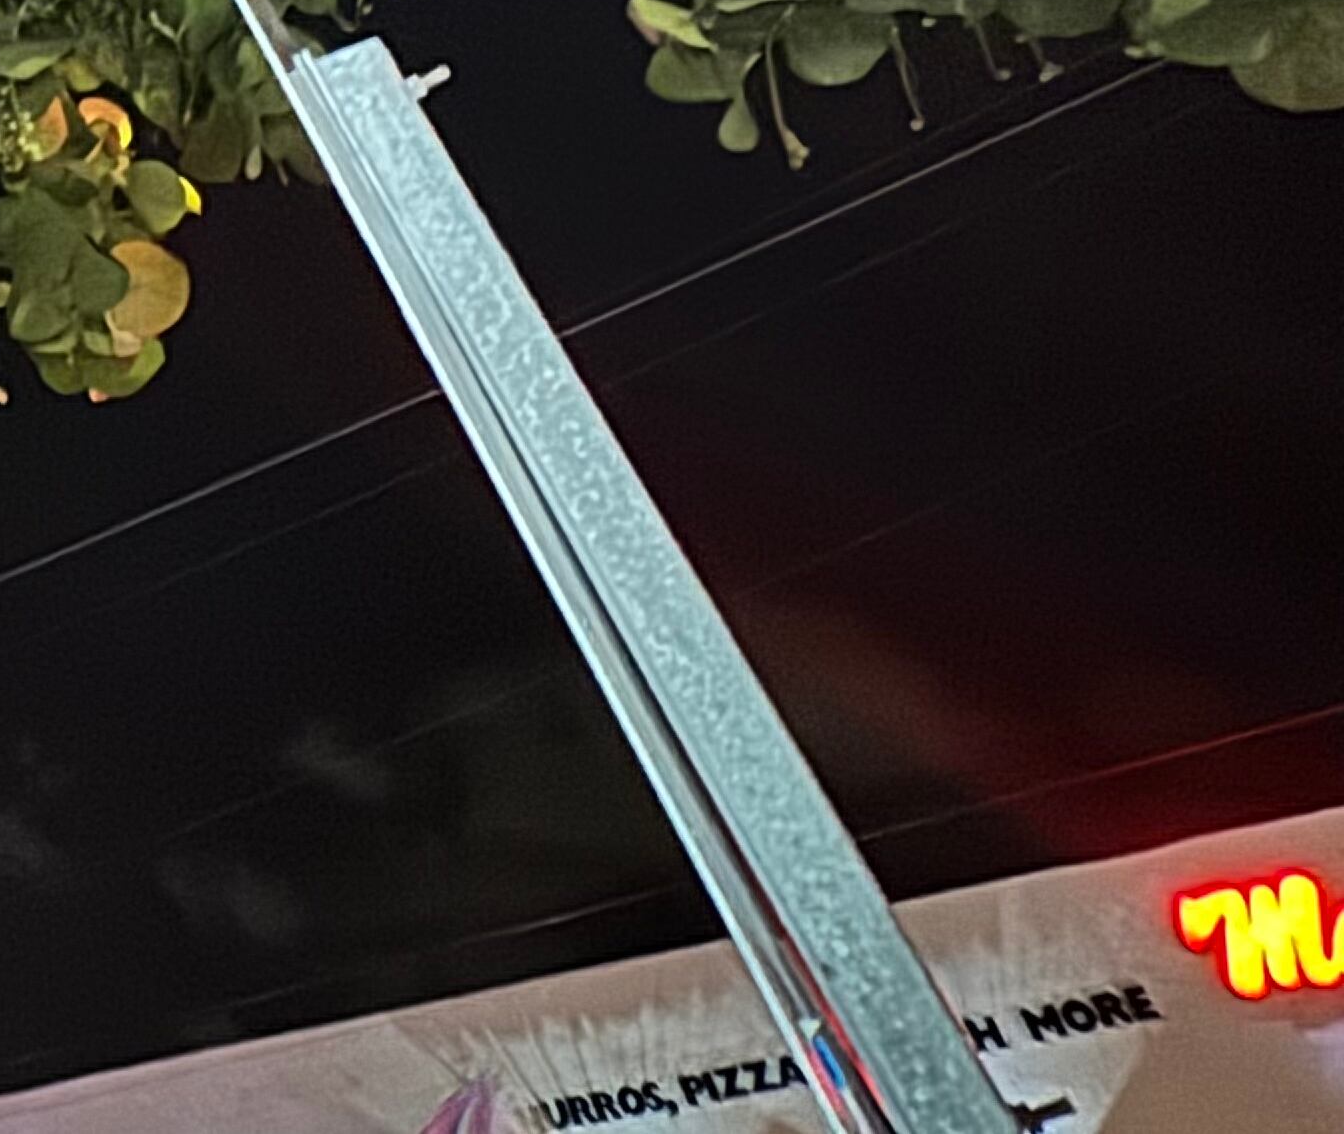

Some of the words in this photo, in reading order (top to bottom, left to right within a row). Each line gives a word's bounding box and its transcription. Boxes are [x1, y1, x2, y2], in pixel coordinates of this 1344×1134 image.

[1176, 870, 1344, 999] M
[532, 1079, 679, 1129] URROS,
[1019, 985, 1164, 1042] MORE
